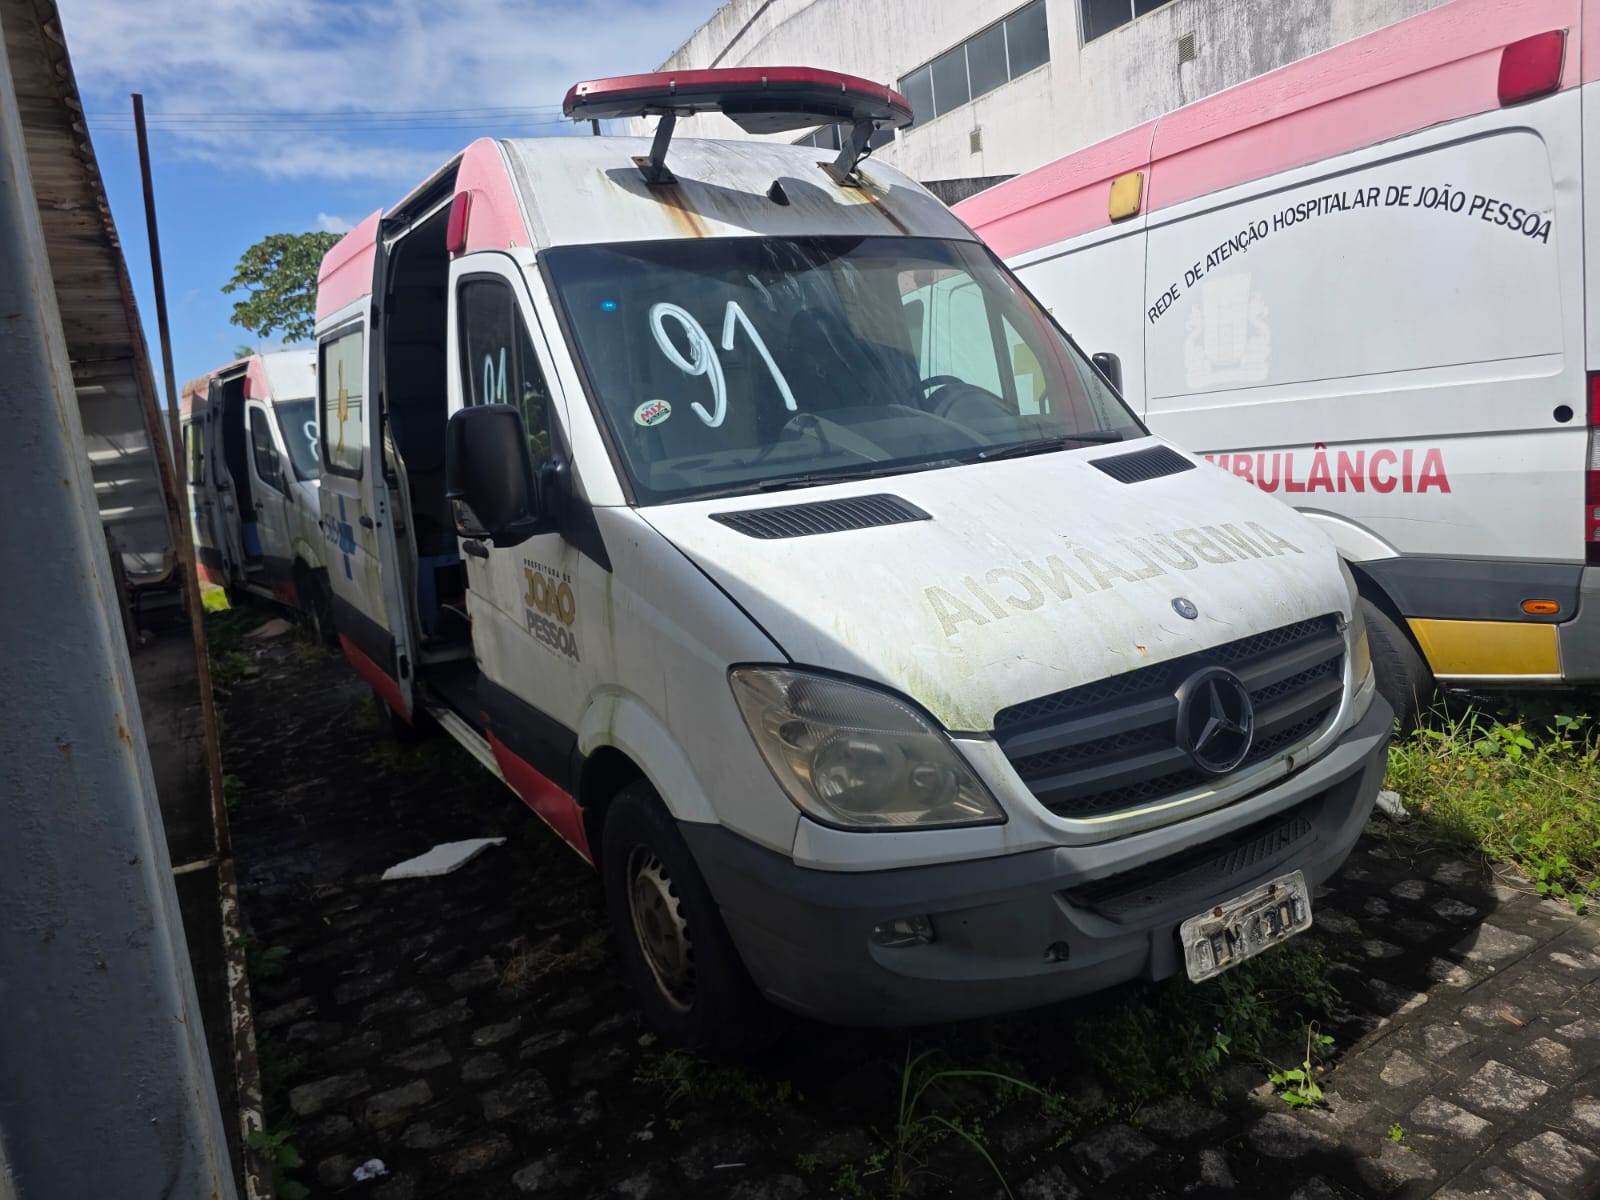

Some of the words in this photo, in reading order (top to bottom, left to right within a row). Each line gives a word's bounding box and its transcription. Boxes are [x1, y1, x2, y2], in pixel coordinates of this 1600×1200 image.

[1147, 282, 1181, 325] REDE
[1184, 261, 1205, 288] DE
[1206, 220, 1269, 273] ATENÇÃO
[1273, 187, 1380, 232] HOSPITALAR
[1385, 186, 1412, 206] DE
[1413, 184, 1465, 213] JOÃO
[1468, 195, 1552, 244] PESSOA
[649, 301, 798, 427] 91
[1205, 442, 1451, 493] BULÂNCIA
[526, 608, 581, 663] PESSOA
